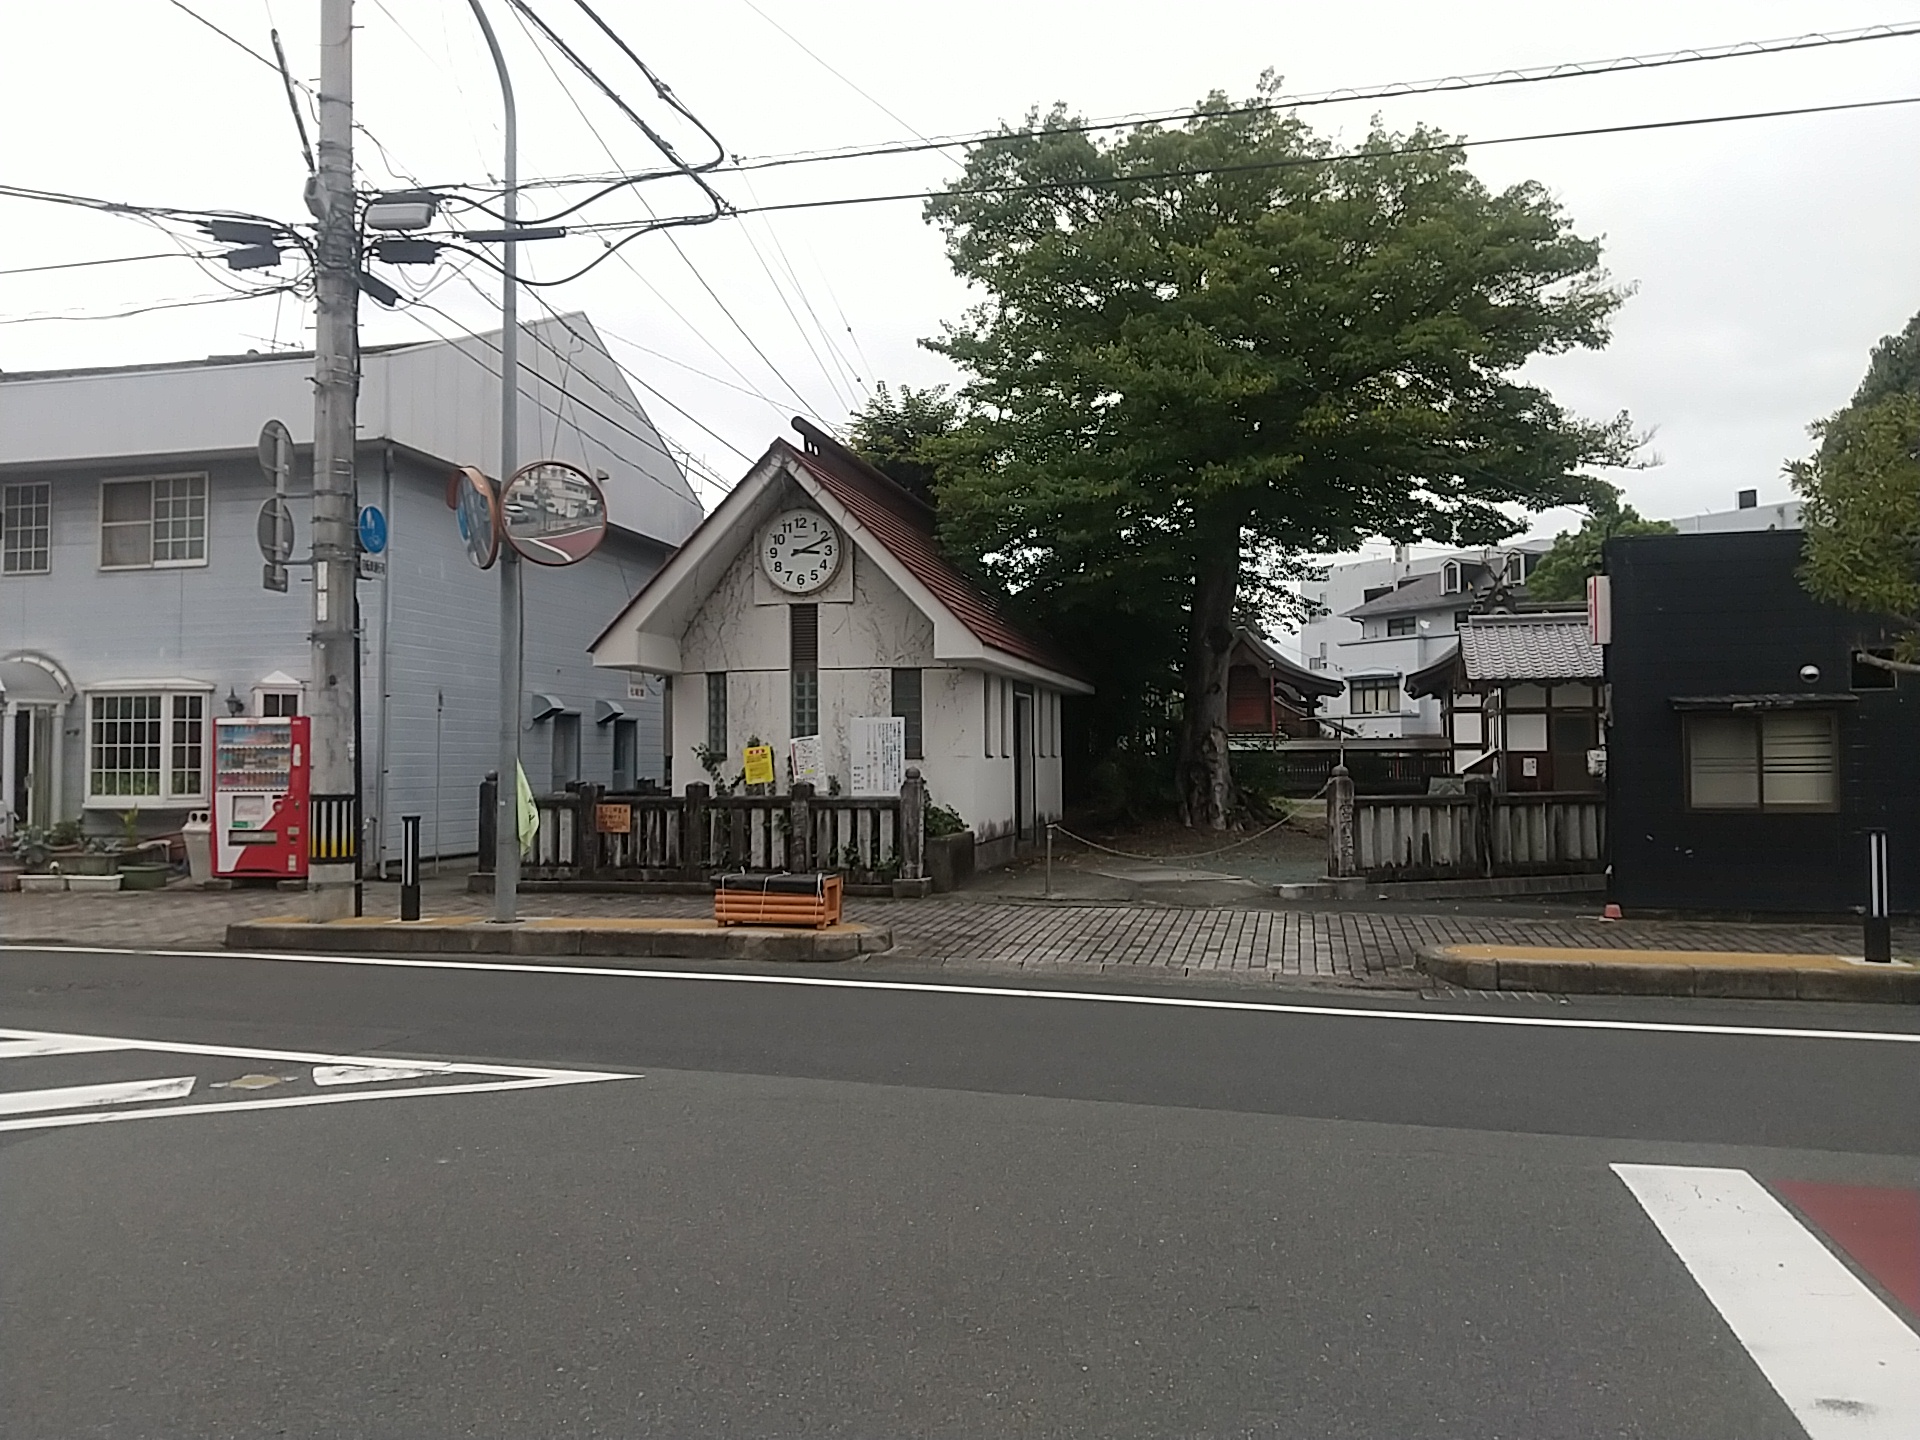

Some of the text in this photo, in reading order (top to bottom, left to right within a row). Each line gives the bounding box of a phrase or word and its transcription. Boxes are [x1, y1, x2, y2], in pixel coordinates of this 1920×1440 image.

[781, 522, 792, 533] 11
[794, 517, 807, 528] 12
[812, 521, 818, 532] 1
[772, 533, 785, 545] 10
[820, 530, 829, 541] 2
[769, 547, 778, 558] 9
[824, 545, 833, 556] 3
[774, 561, 782, 572] 8
[819, 559, 827, 570] 4
[784, 570, 793, 582] 7
[796, 573, 805, 585] 6
[810, 569, 818, 581] 5
